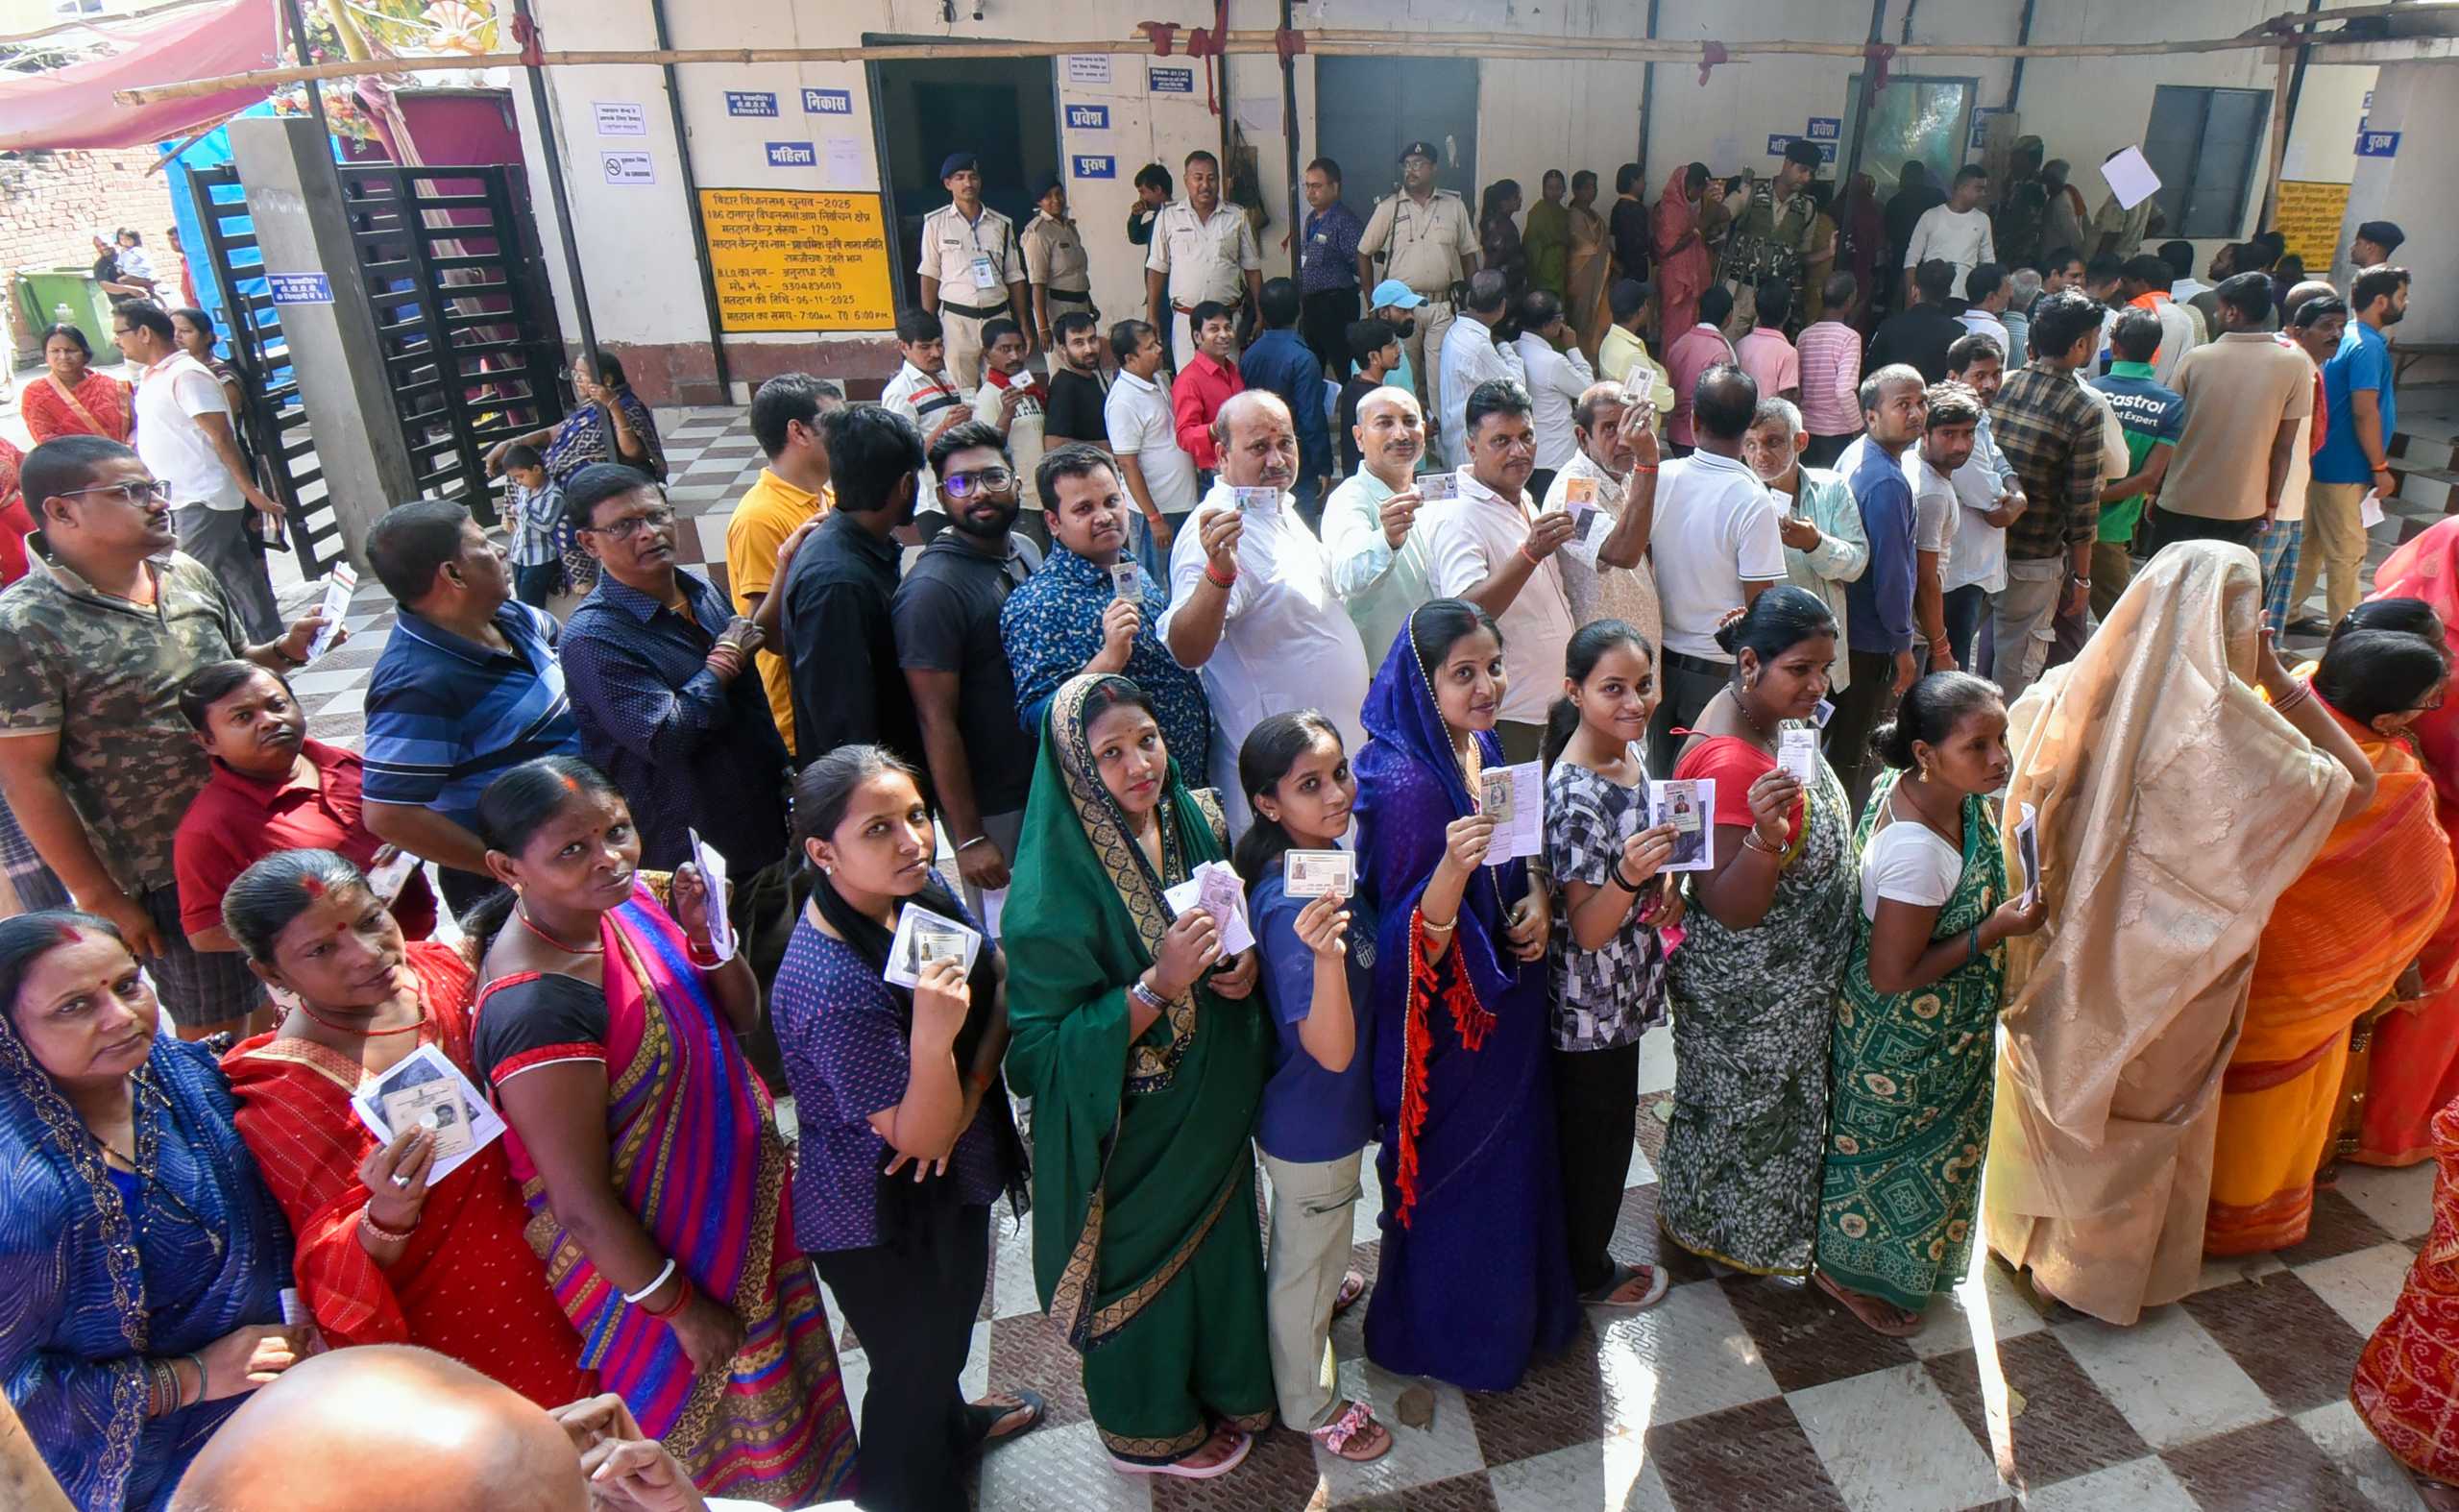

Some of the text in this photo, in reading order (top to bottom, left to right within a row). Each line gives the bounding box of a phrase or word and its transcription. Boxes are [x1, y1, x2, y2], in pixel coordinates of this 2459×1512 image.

[806, 91, 846, 110] निकास
[1071, 108, 1103, 126] प्रवेश
[1813, 120, 1836, 136] प्रवेश
[770, 146, 811, 162] महिला
[713, 192, 738, 205] बिहार
[788, 198, 815, 209] चुनाव
[722, 224, 750, 235] मतदान
[812, 225, 829, 236] 179
[722, 296, 752, 305] मतदान
[2124, 410, 2158, 427] Expert
